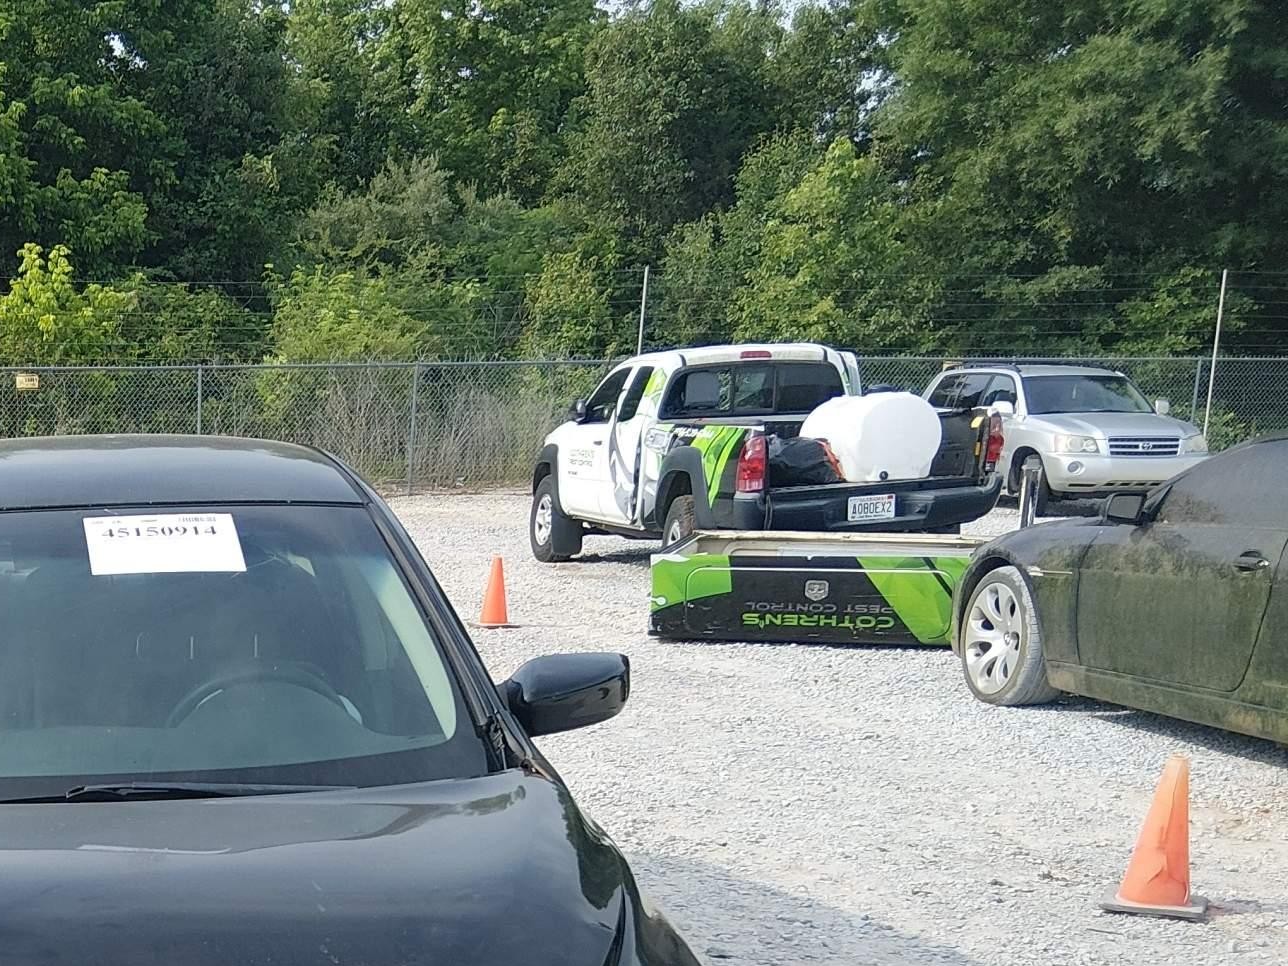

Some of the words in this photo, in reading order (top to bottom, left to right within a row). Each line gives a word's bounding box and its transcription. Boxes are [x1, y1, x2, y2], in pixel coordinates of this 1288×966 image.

[101, 525, 218, 539] 45150914
[745, 601, 837, 613] CONTROL
[843, 604, 894, 614] PEST
[741, 613, 895, 628] COTHREN'S
